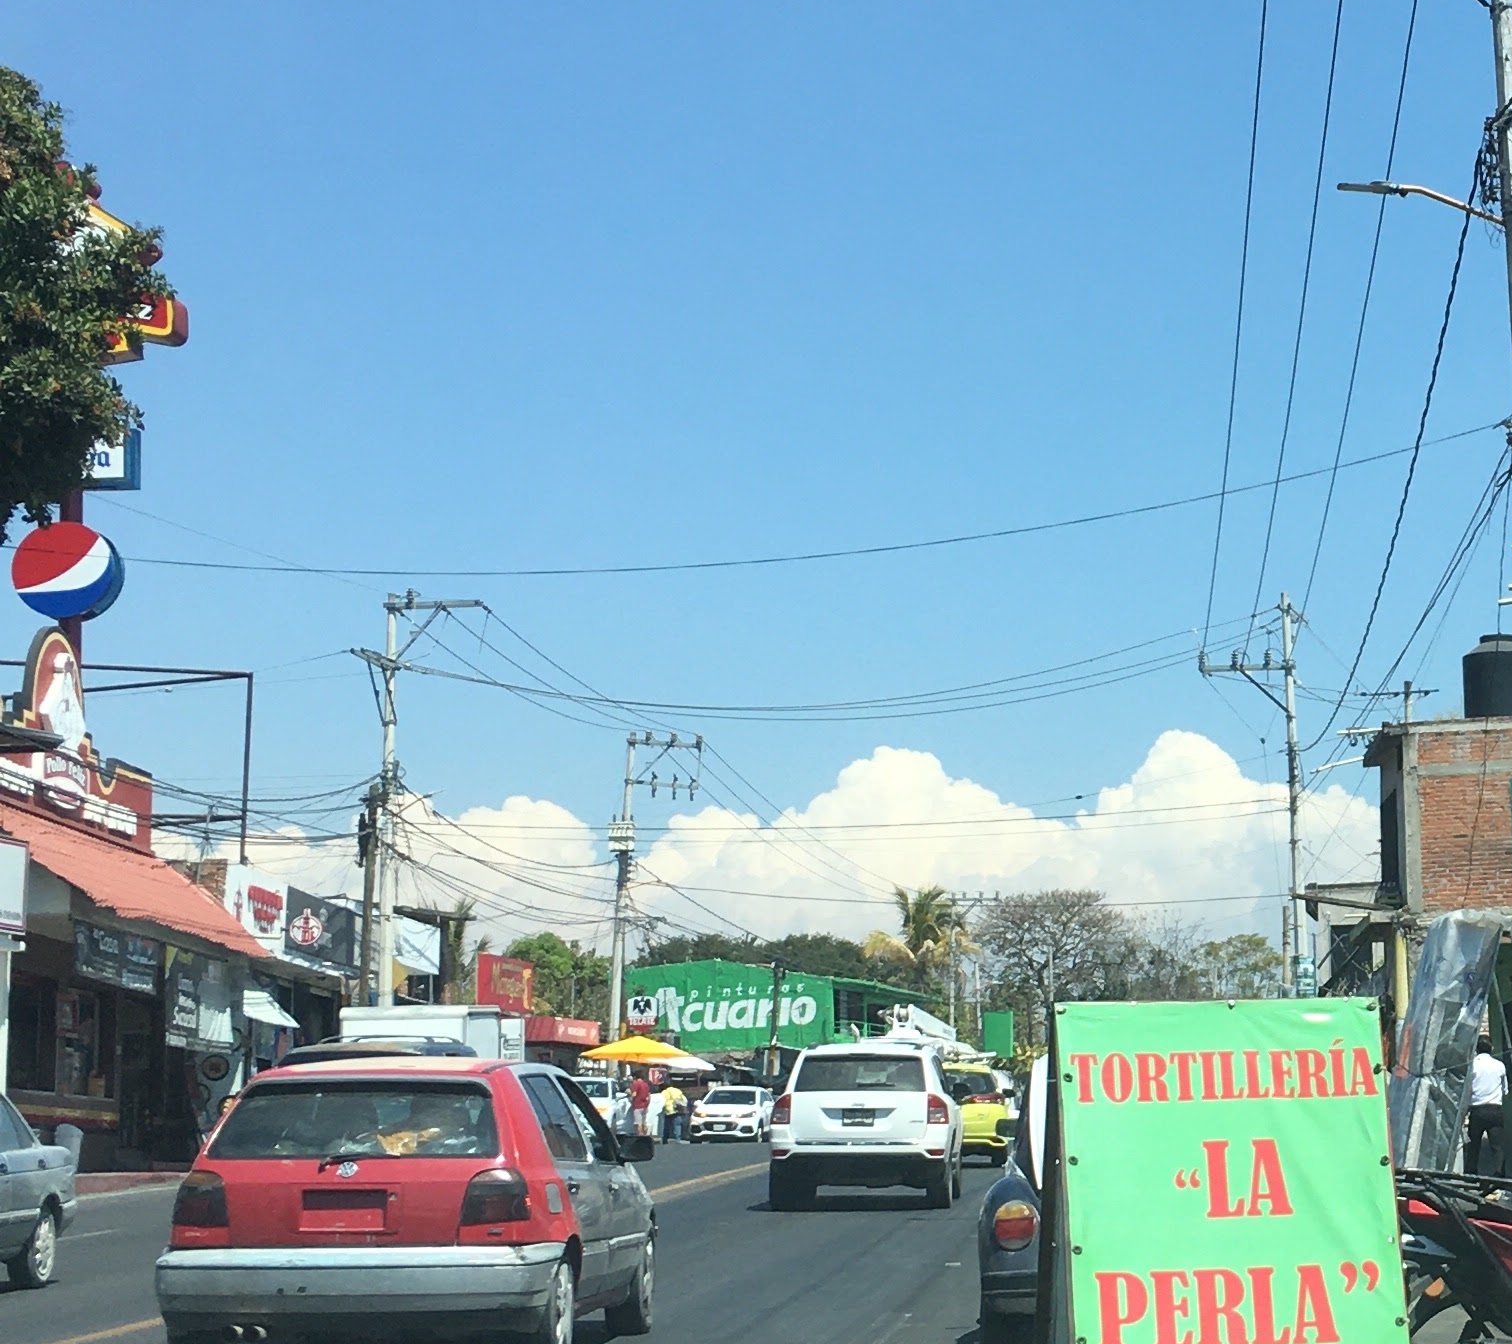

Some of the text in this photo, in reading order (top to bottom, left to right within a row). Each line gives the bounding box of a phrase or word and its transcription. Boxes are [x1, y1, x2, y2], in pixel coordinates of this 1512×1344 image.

[690, 982, 805, 1002] pinturas
[628, 1016, 657, 1026] TECATE
[655, 987, 817, 1033] Acuario
[1070, 1038, 1379, 1103] TORTILLERÍA
